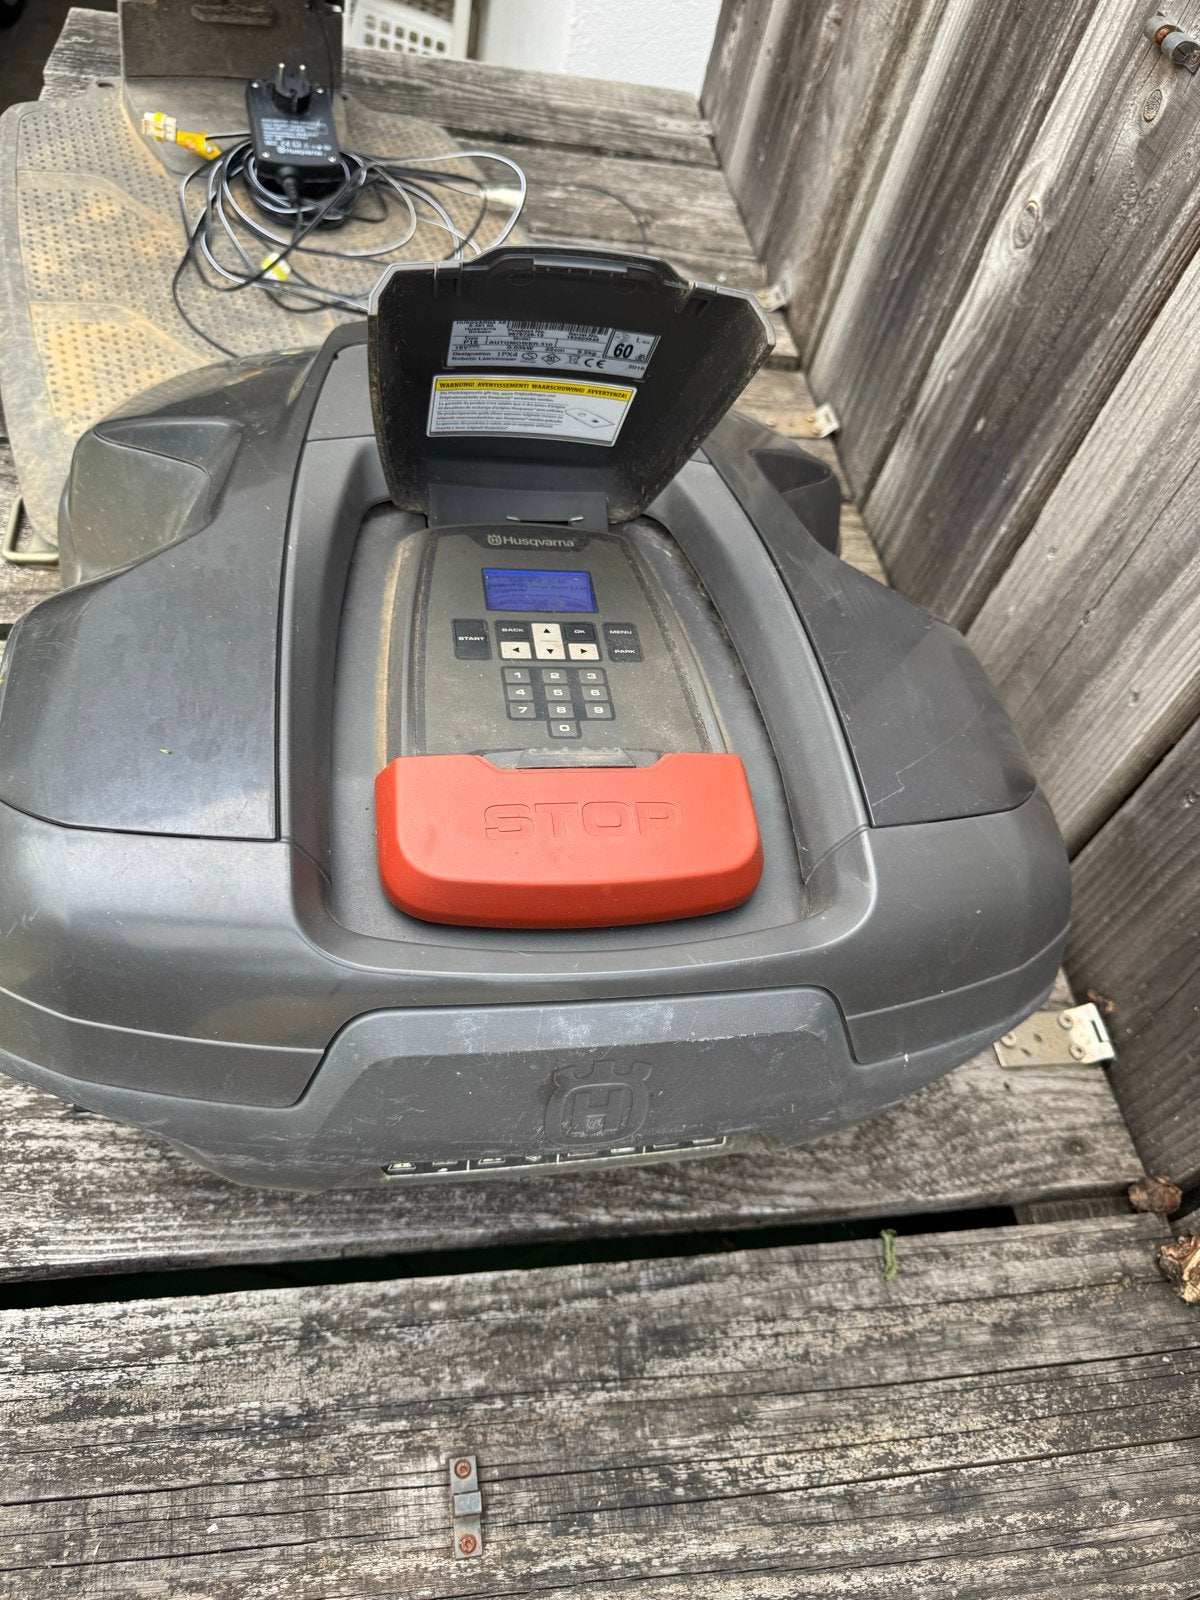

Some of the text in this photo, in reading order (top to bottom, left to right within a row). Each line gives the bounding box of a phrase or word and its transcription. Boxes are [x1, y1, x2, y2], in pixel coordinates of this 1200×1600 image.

[613, 343, 634, 359] 60
[531, 384, 586, 393] WAARSCHUWING!
[587, 388, 628, 398] AVVERTENZA!
[502, 536, 575, 548] Husqvarna
[586, 672, 597, 680] 3
[515, 688, 526, 696] 4
[593, 706, 604, 714] 9
[484, 801, 681, 840] STOP
